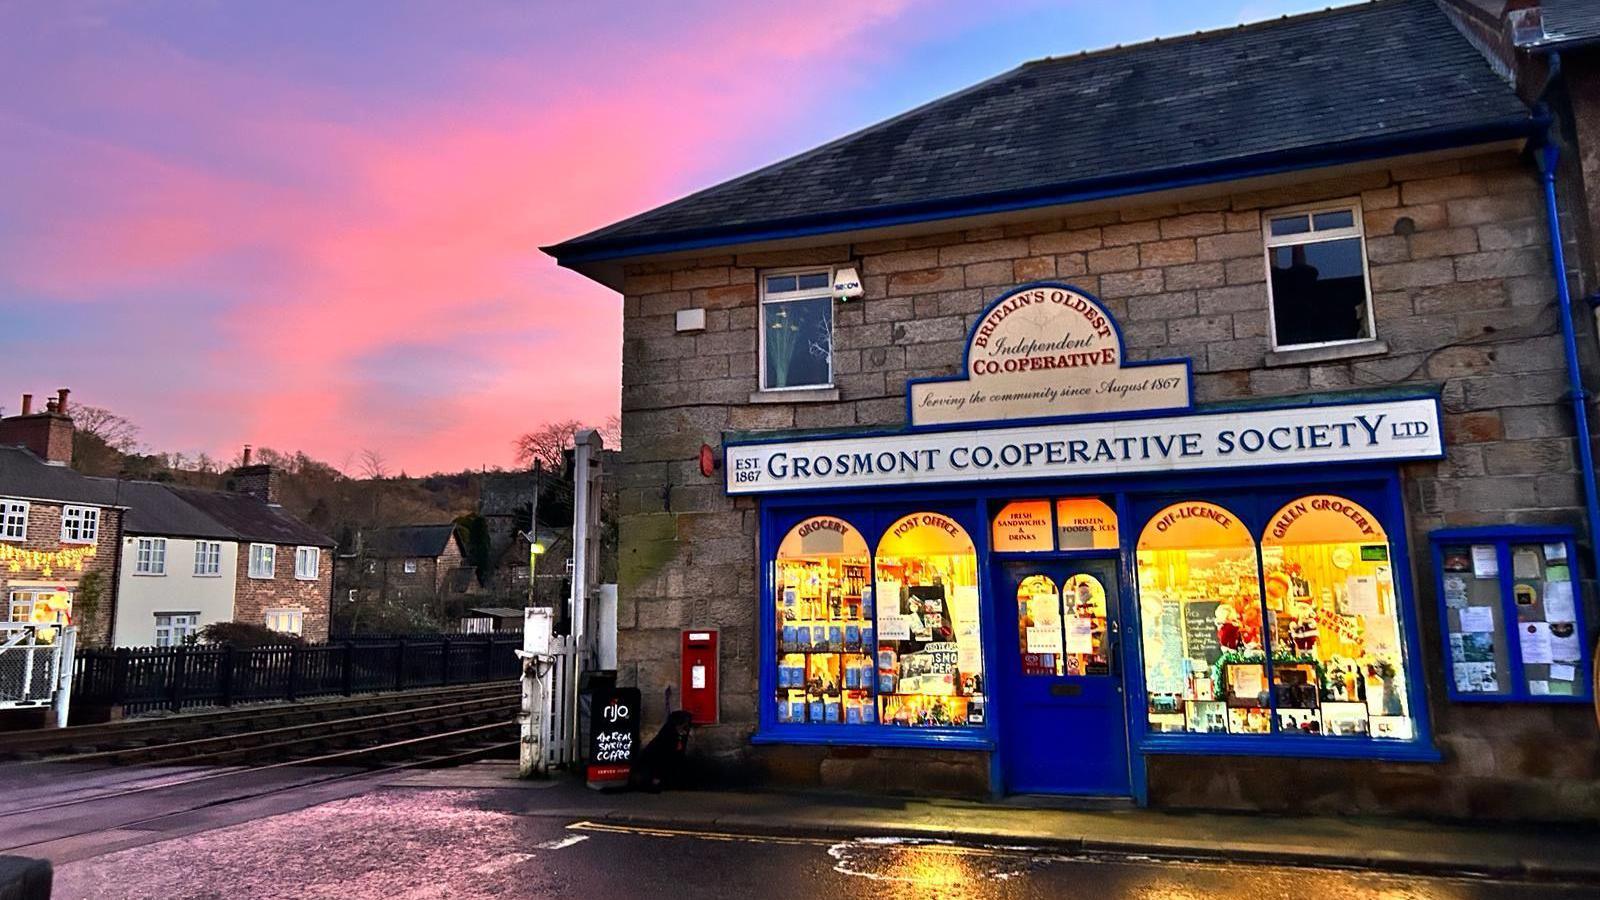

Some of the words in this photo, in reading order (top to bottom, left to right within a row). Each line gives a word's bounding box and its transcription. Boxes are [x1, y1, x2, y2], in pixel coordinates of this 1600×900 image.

[975, 291, 1045, 348] BRITAIN'S
[1050, 291, 1111, 339] OLDEST
[988, 333, 1094, 357] Independent
[918, 392, 965, 409] Serving
[969, 390, 985, 403] the
[989, 387, 1057, 402] community
[1060, 386, 1091, 396] since
[1095, 378, 1148, 398] August
[1151, 377, 1180, 390] 1867
[767, 449, 940, 479] GROSMONT
[950, 433, 1203, 470] CO.OPERATIVE
[1217, 414, 1386, 454] SOCIETY
[1391, 420, 1429, 438] LTD
[735, 471, 761, 482] 1867
[798, 519, 849, 537] GROCERY
[894, 517, 919, 538] POST
[922, 515, 960, 538] OFFICE
[997, 519, 1047, 527] SANDWICHES
[1073, 517, 1104, 525] FROZEN
[1156, 507, 1232, 533] OFF-LICENCE
[1272, 502, 1308, 538] GREEN
[1311, 499, 1375, 535] GROCERY
[603, 699, 629, 722] rijo
